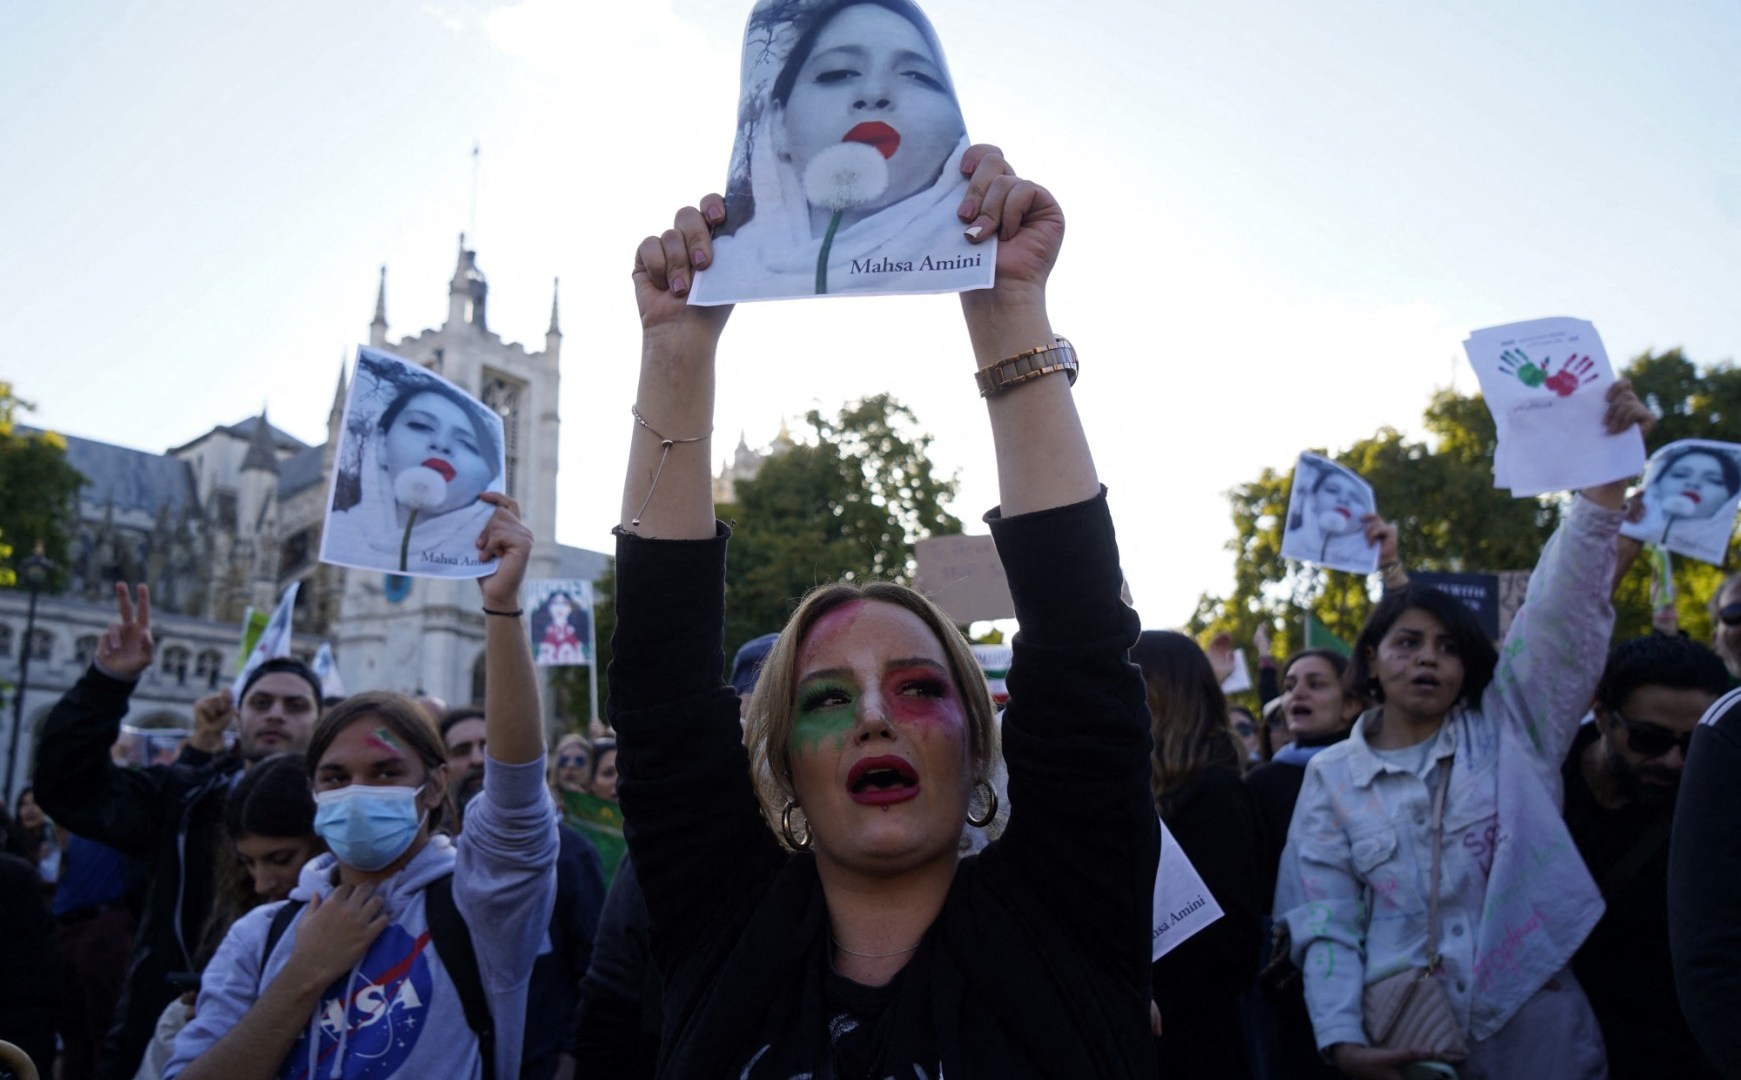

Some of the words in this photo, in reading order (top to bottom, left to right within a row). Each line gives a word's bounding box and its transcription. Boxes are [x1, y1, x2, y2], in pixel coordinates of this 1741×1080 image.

[850, 257, 913, 275] Mahsa
[919, 253, 981, 271] Amini
[420, 550, 459, 566] Mahsa
[1170, 895, 1206, 925] Amini
[300, 976, 424, 1039] ASA
